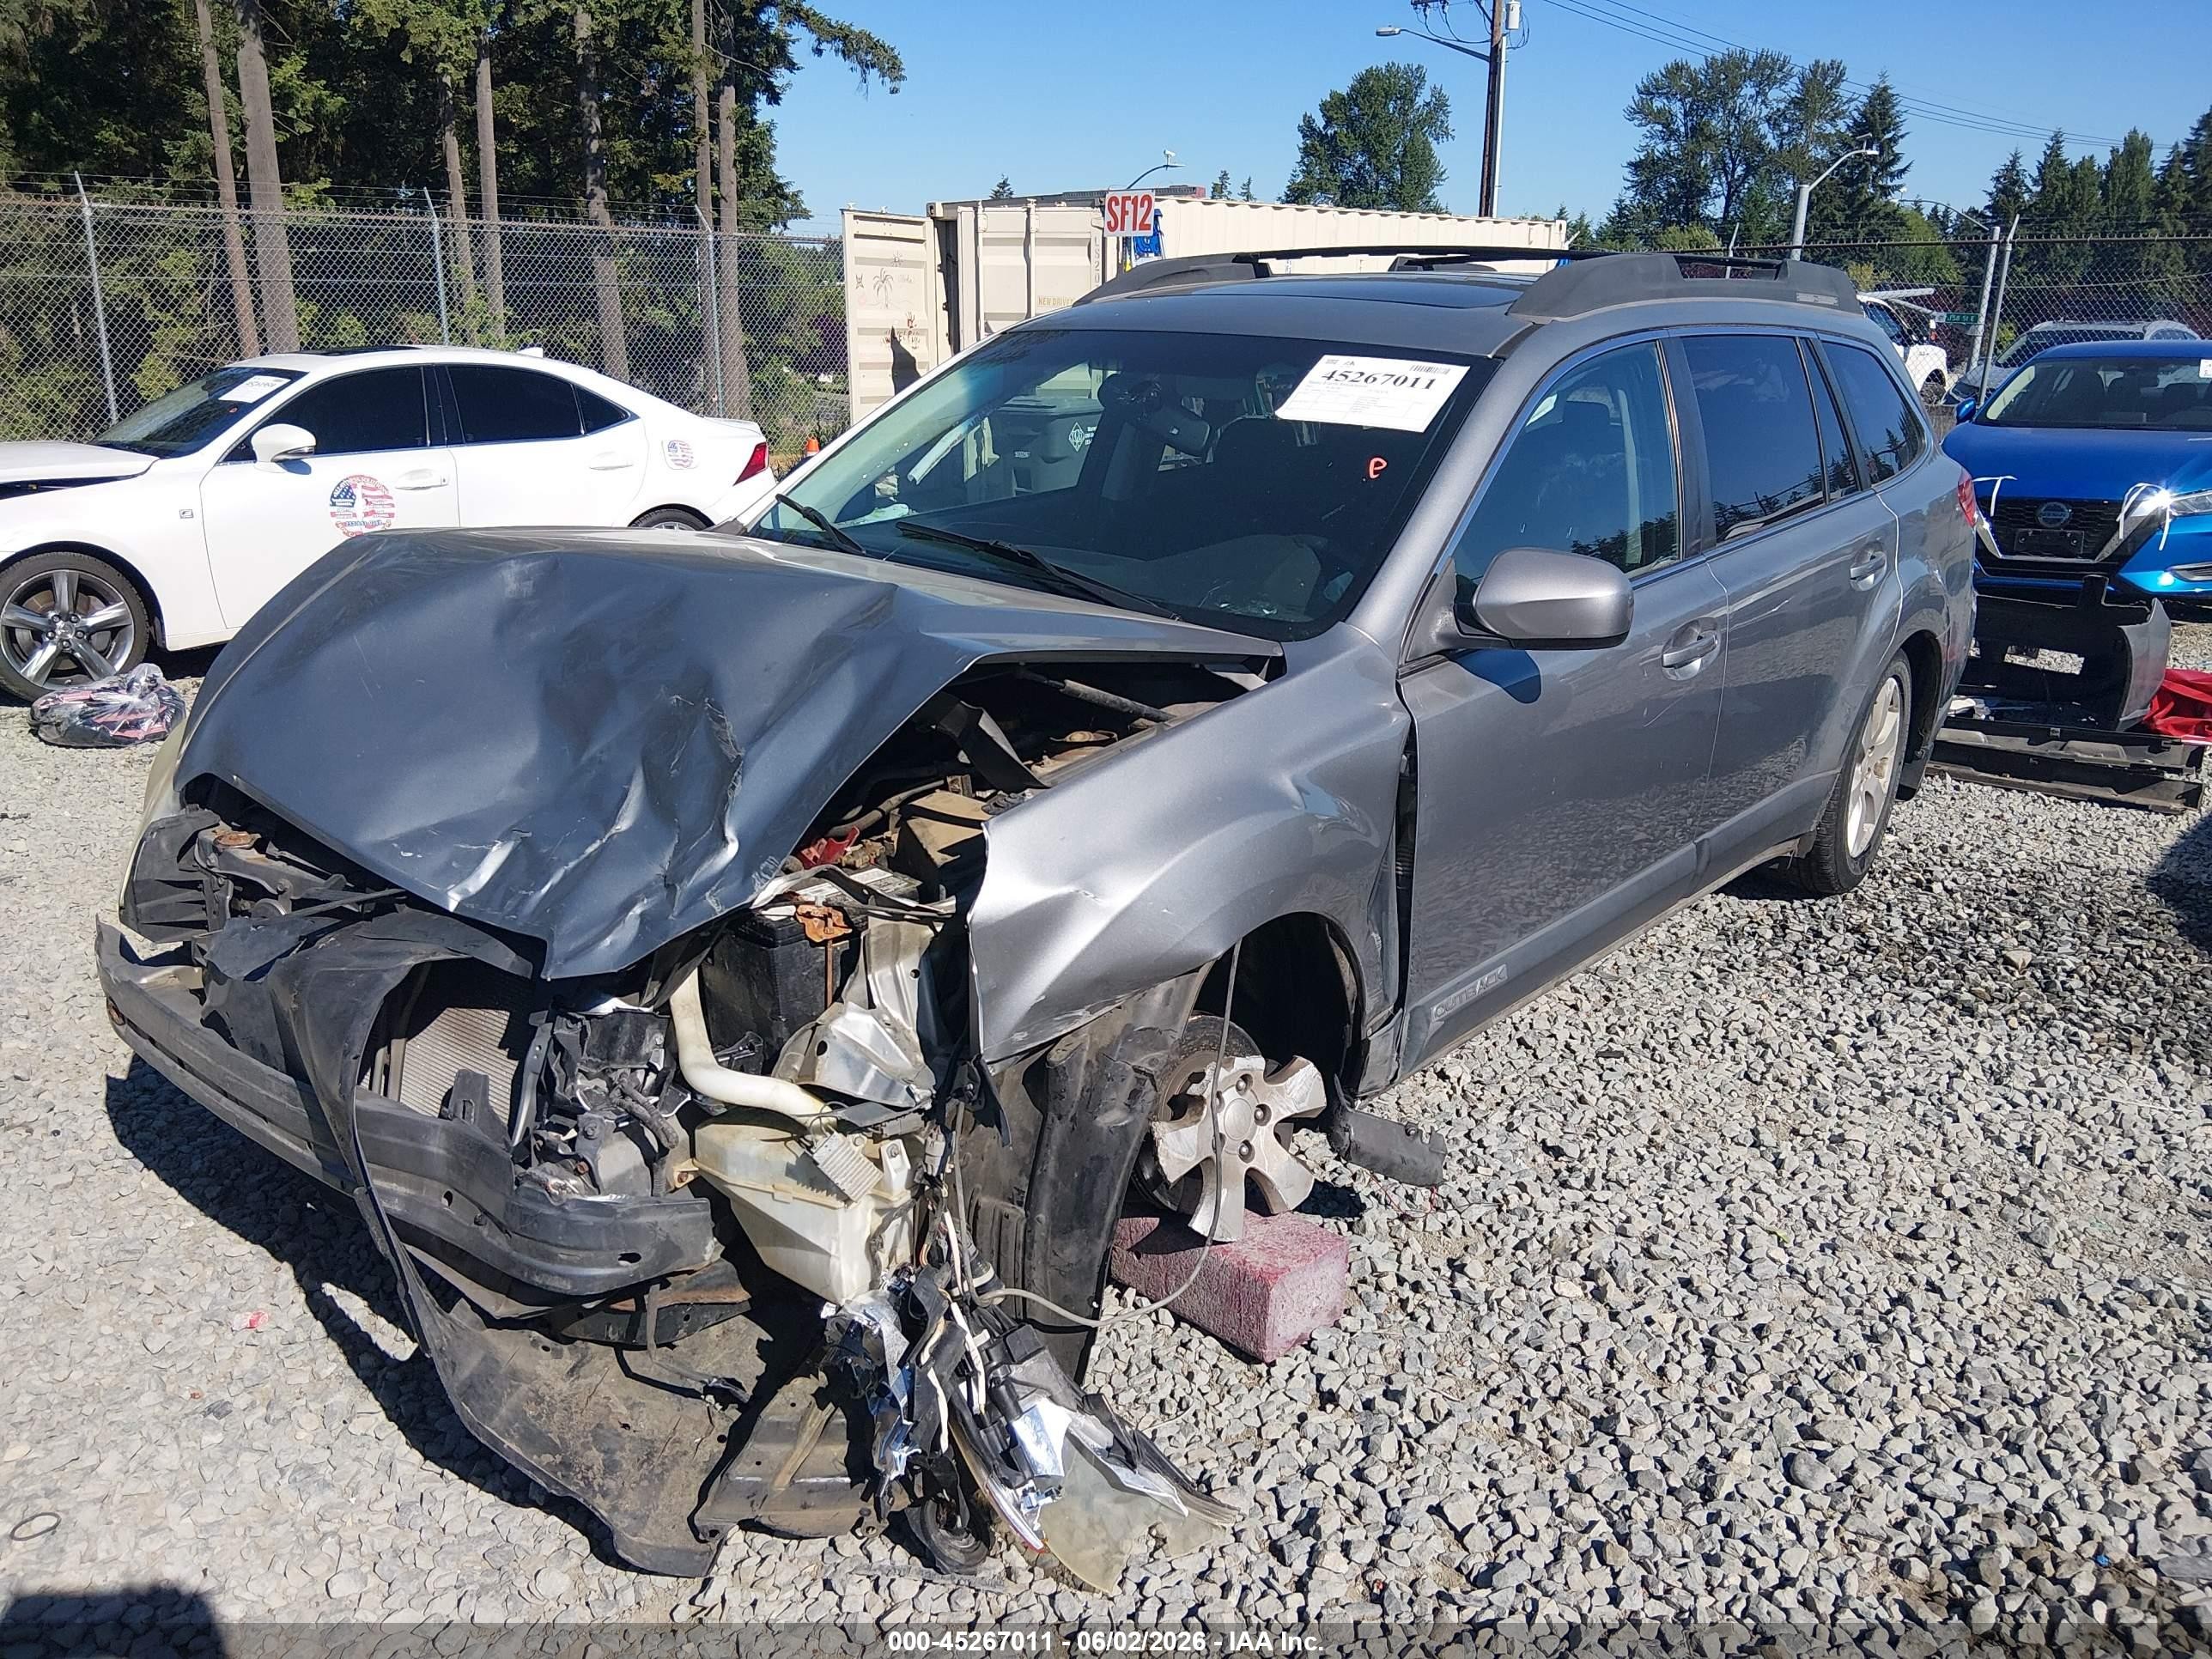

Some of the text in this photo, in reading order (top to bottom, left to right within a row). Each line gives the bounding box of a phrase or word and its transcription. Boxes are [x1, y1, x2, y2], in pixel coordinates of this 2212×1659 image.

[1106, 194, 1153, 233] SF12
[1322, 369, 1437, 390] 45267011
[1432, 966, 1506, 1018] OUTBACK
